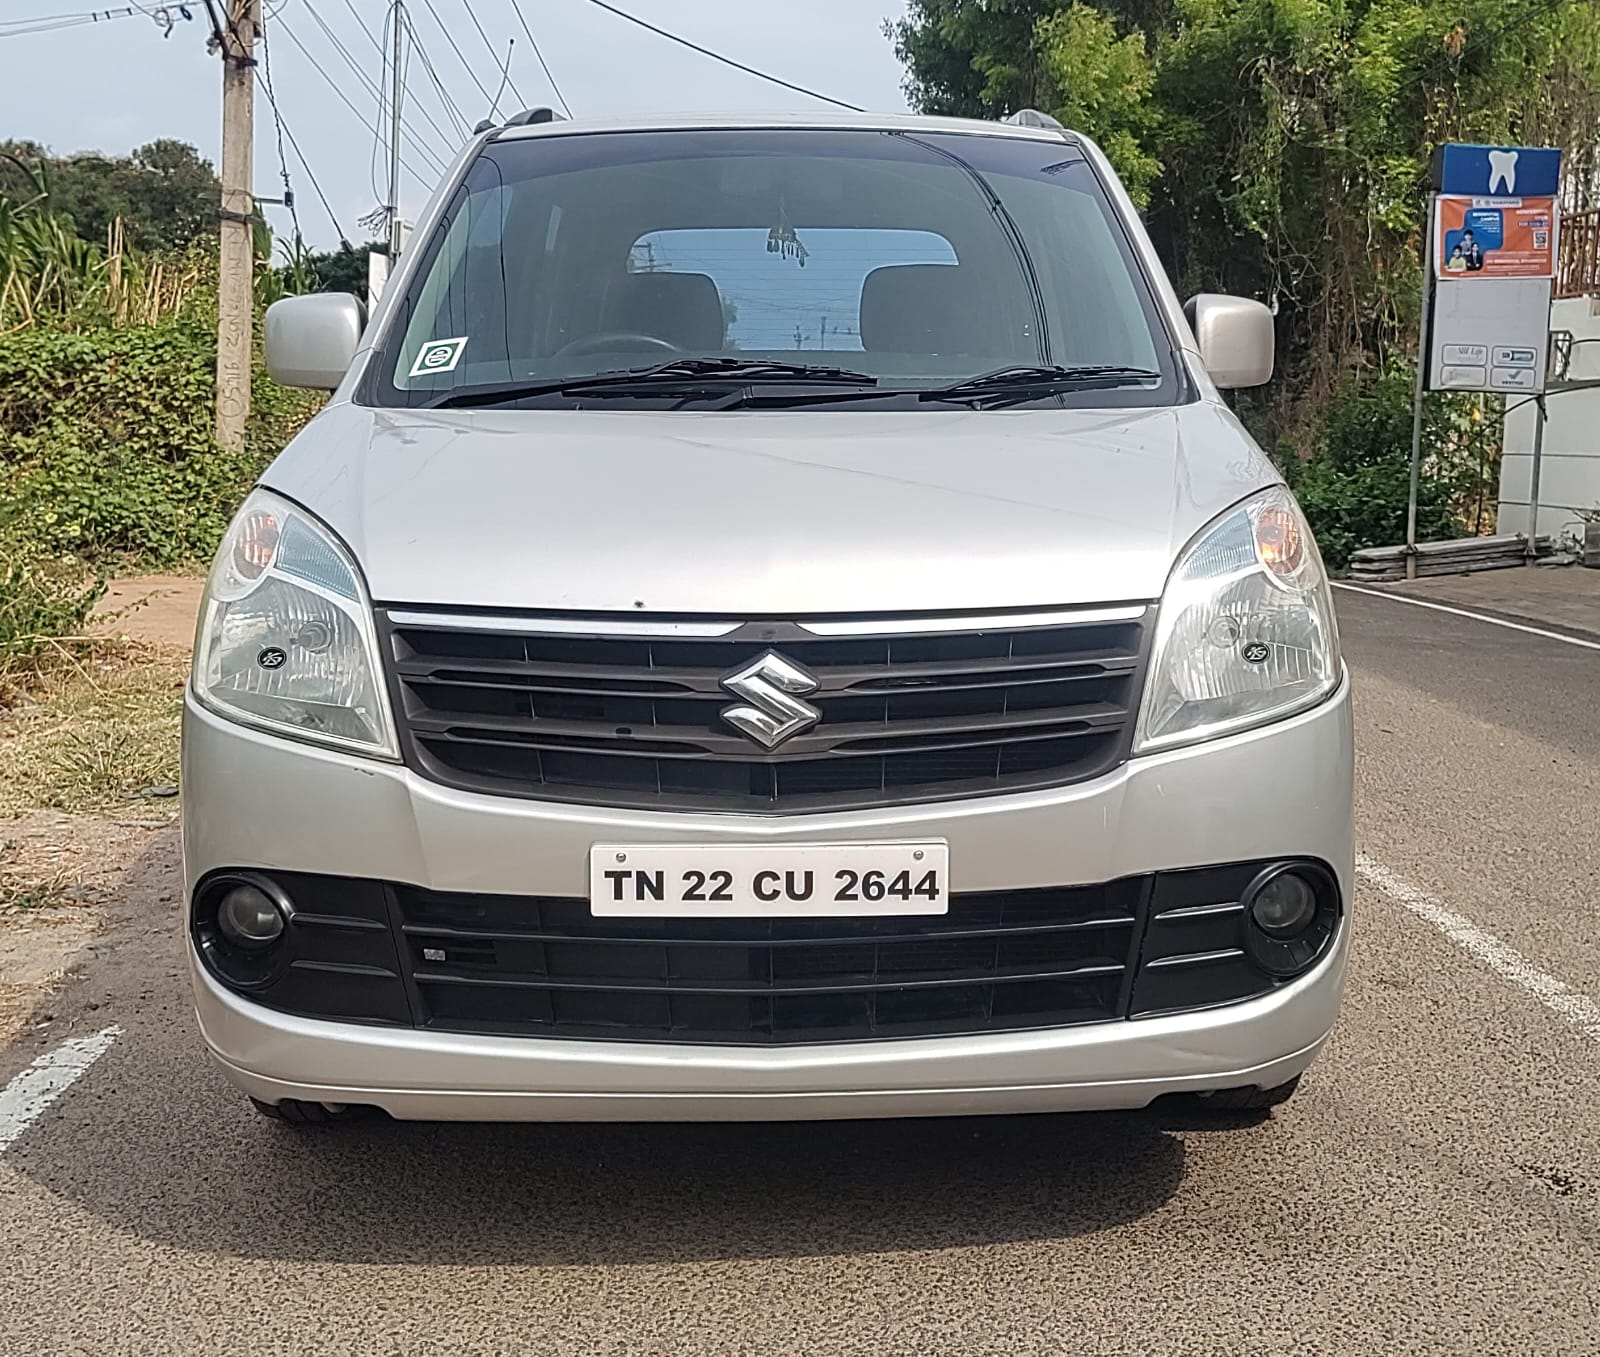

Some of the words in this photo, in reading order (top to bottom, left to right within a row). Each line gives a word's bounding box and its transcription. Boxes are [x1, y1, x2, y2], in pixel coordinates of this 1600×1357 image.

[604, 871, 664, 901] TN
[681, 871, 733, 901] 22
[753, 870, 814, 902] CU
[833, 870, 940, 901] 2644
